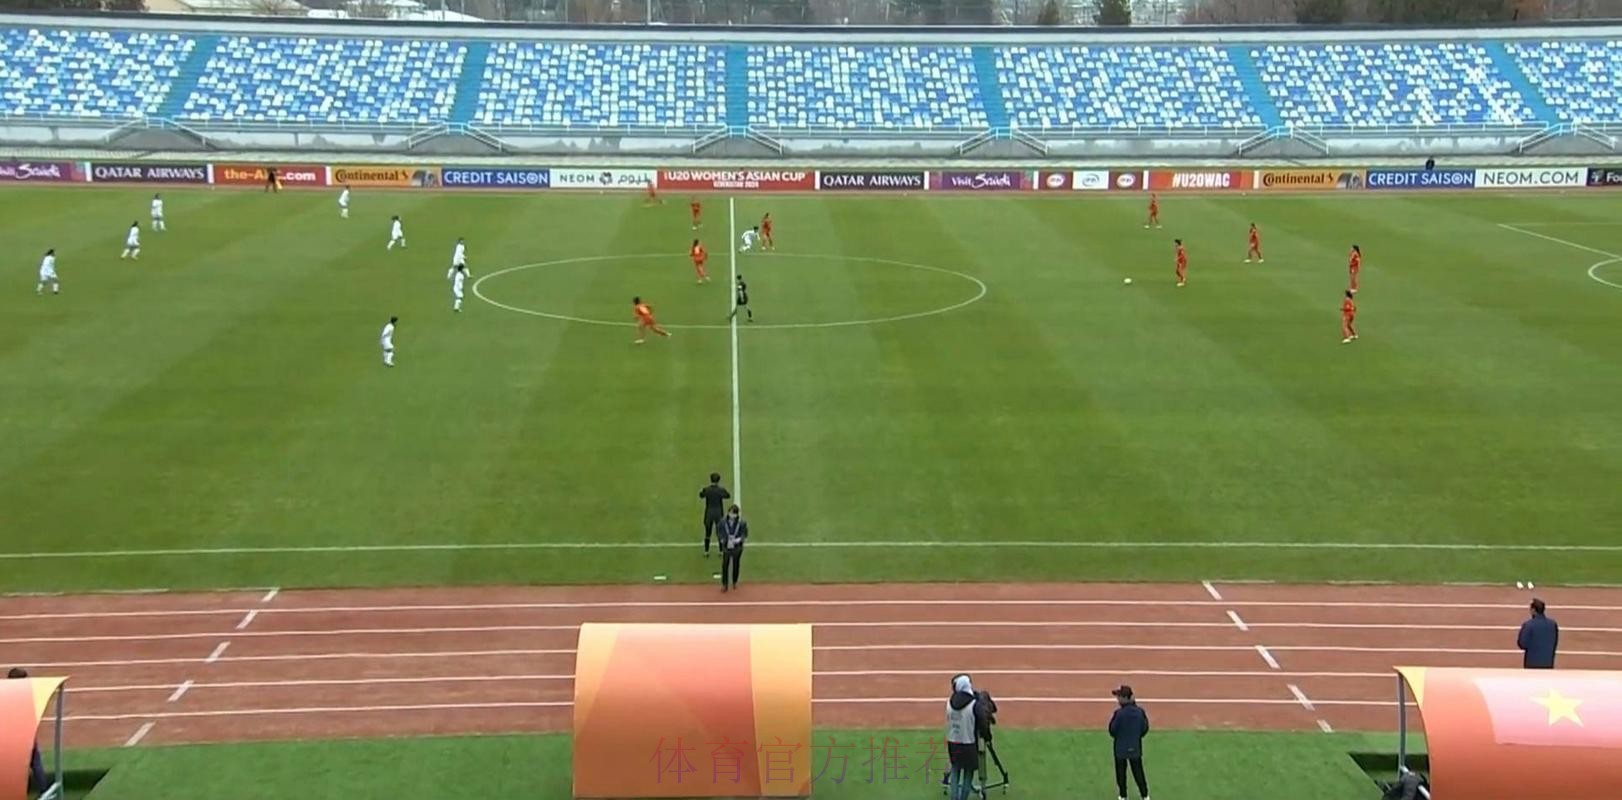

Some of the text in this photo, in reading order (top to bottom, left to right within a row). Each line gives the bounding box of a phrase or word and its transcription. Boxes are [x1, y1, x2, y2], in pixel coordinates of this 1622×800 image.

[94, 166, 204, 179] QATAR AIRWAYS
[335, 168, 398, 182] Continental
[444, 171, 548, 184] CREDIT SAISON
[560, 174, 594, 183] NEOM
[668, 170, 806, 181] U20 WOMEN'S ASIAN CUP
[1368, 172, 1473, 185] CREDIT SAISON
[1483, 170, 1579, 185] NEOM.COM
[823, 175, 921, 187] QATAR AIRWAYS
[951, 173, 1011, 188] Visit Saudi
[1171, 172, 1231, 188] #U20WAC
[1263, 172, 1324, 187] Continental
